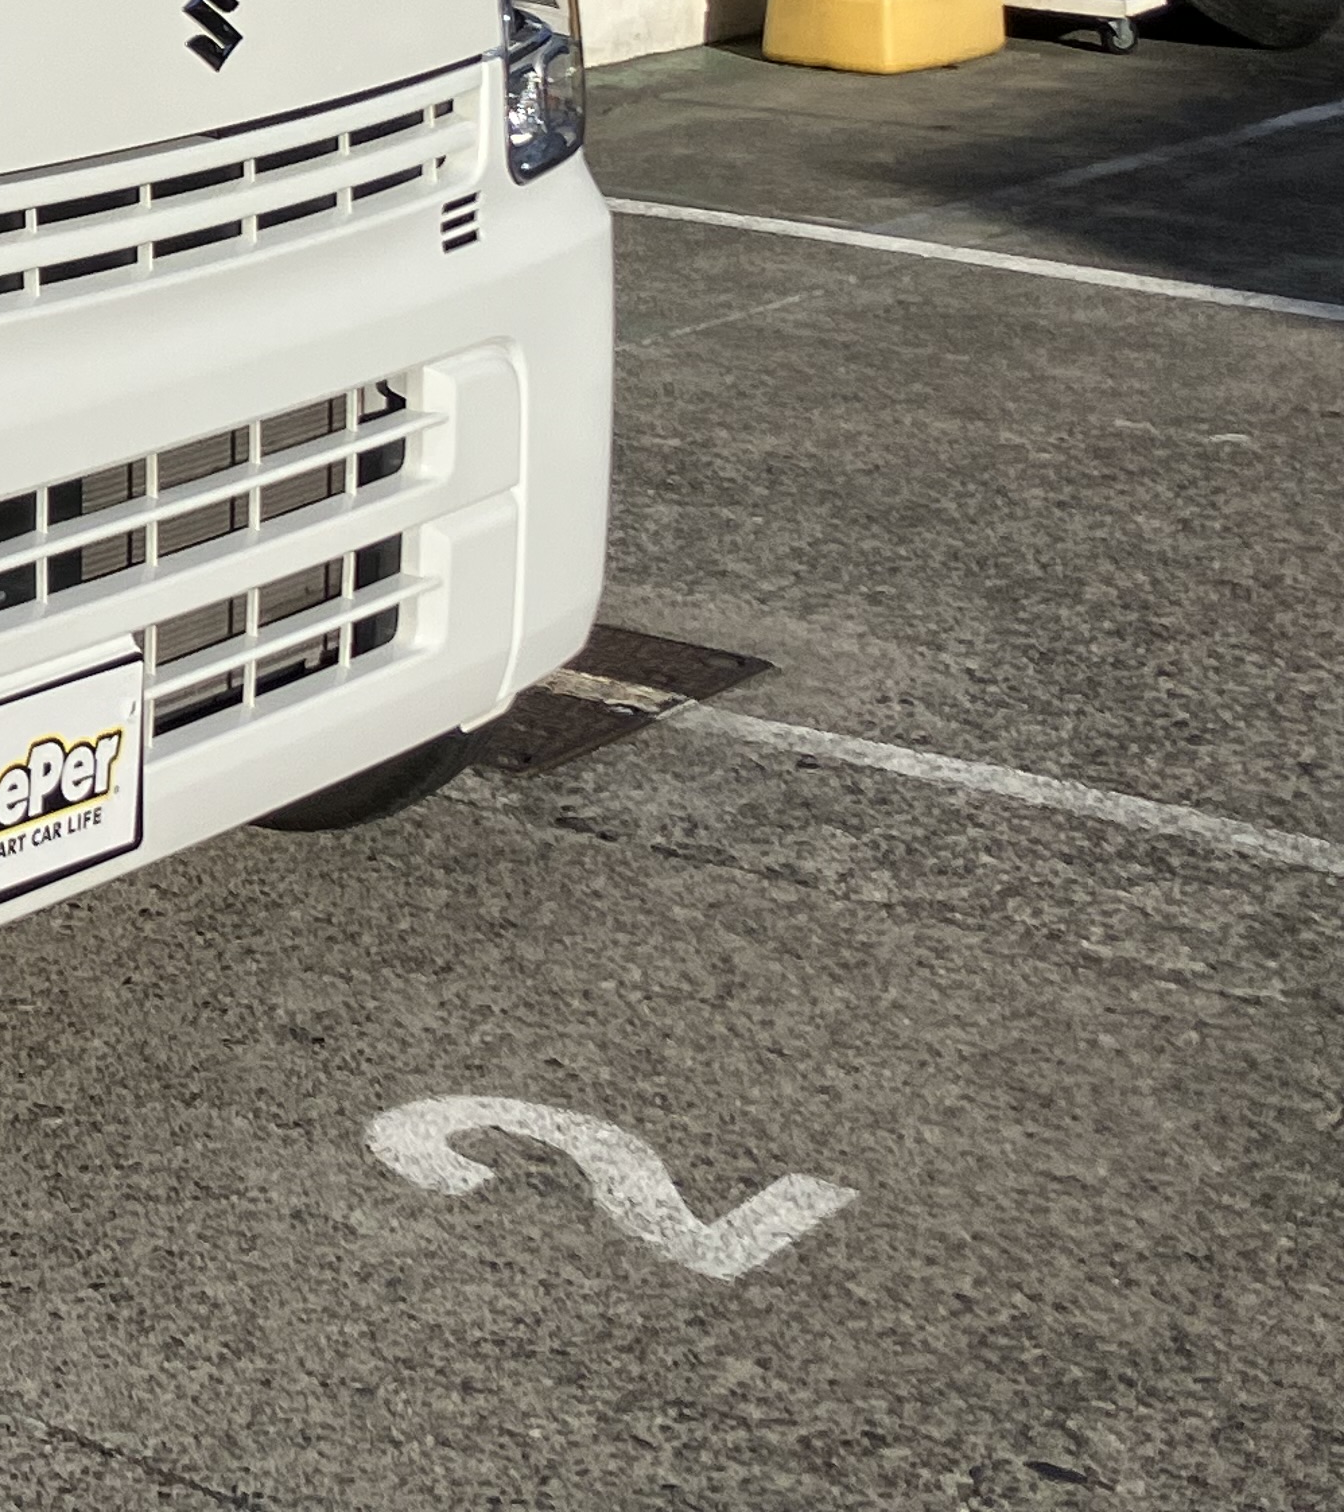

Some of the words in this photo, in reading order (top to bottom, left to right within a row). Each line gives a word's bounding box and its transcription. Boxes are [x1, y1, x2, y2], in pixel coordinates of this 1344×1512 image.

[31, 819, 62, 848] CAR
[67, 805, 103, 835] LIFE
[364, 1095, 862, 1285] 2
